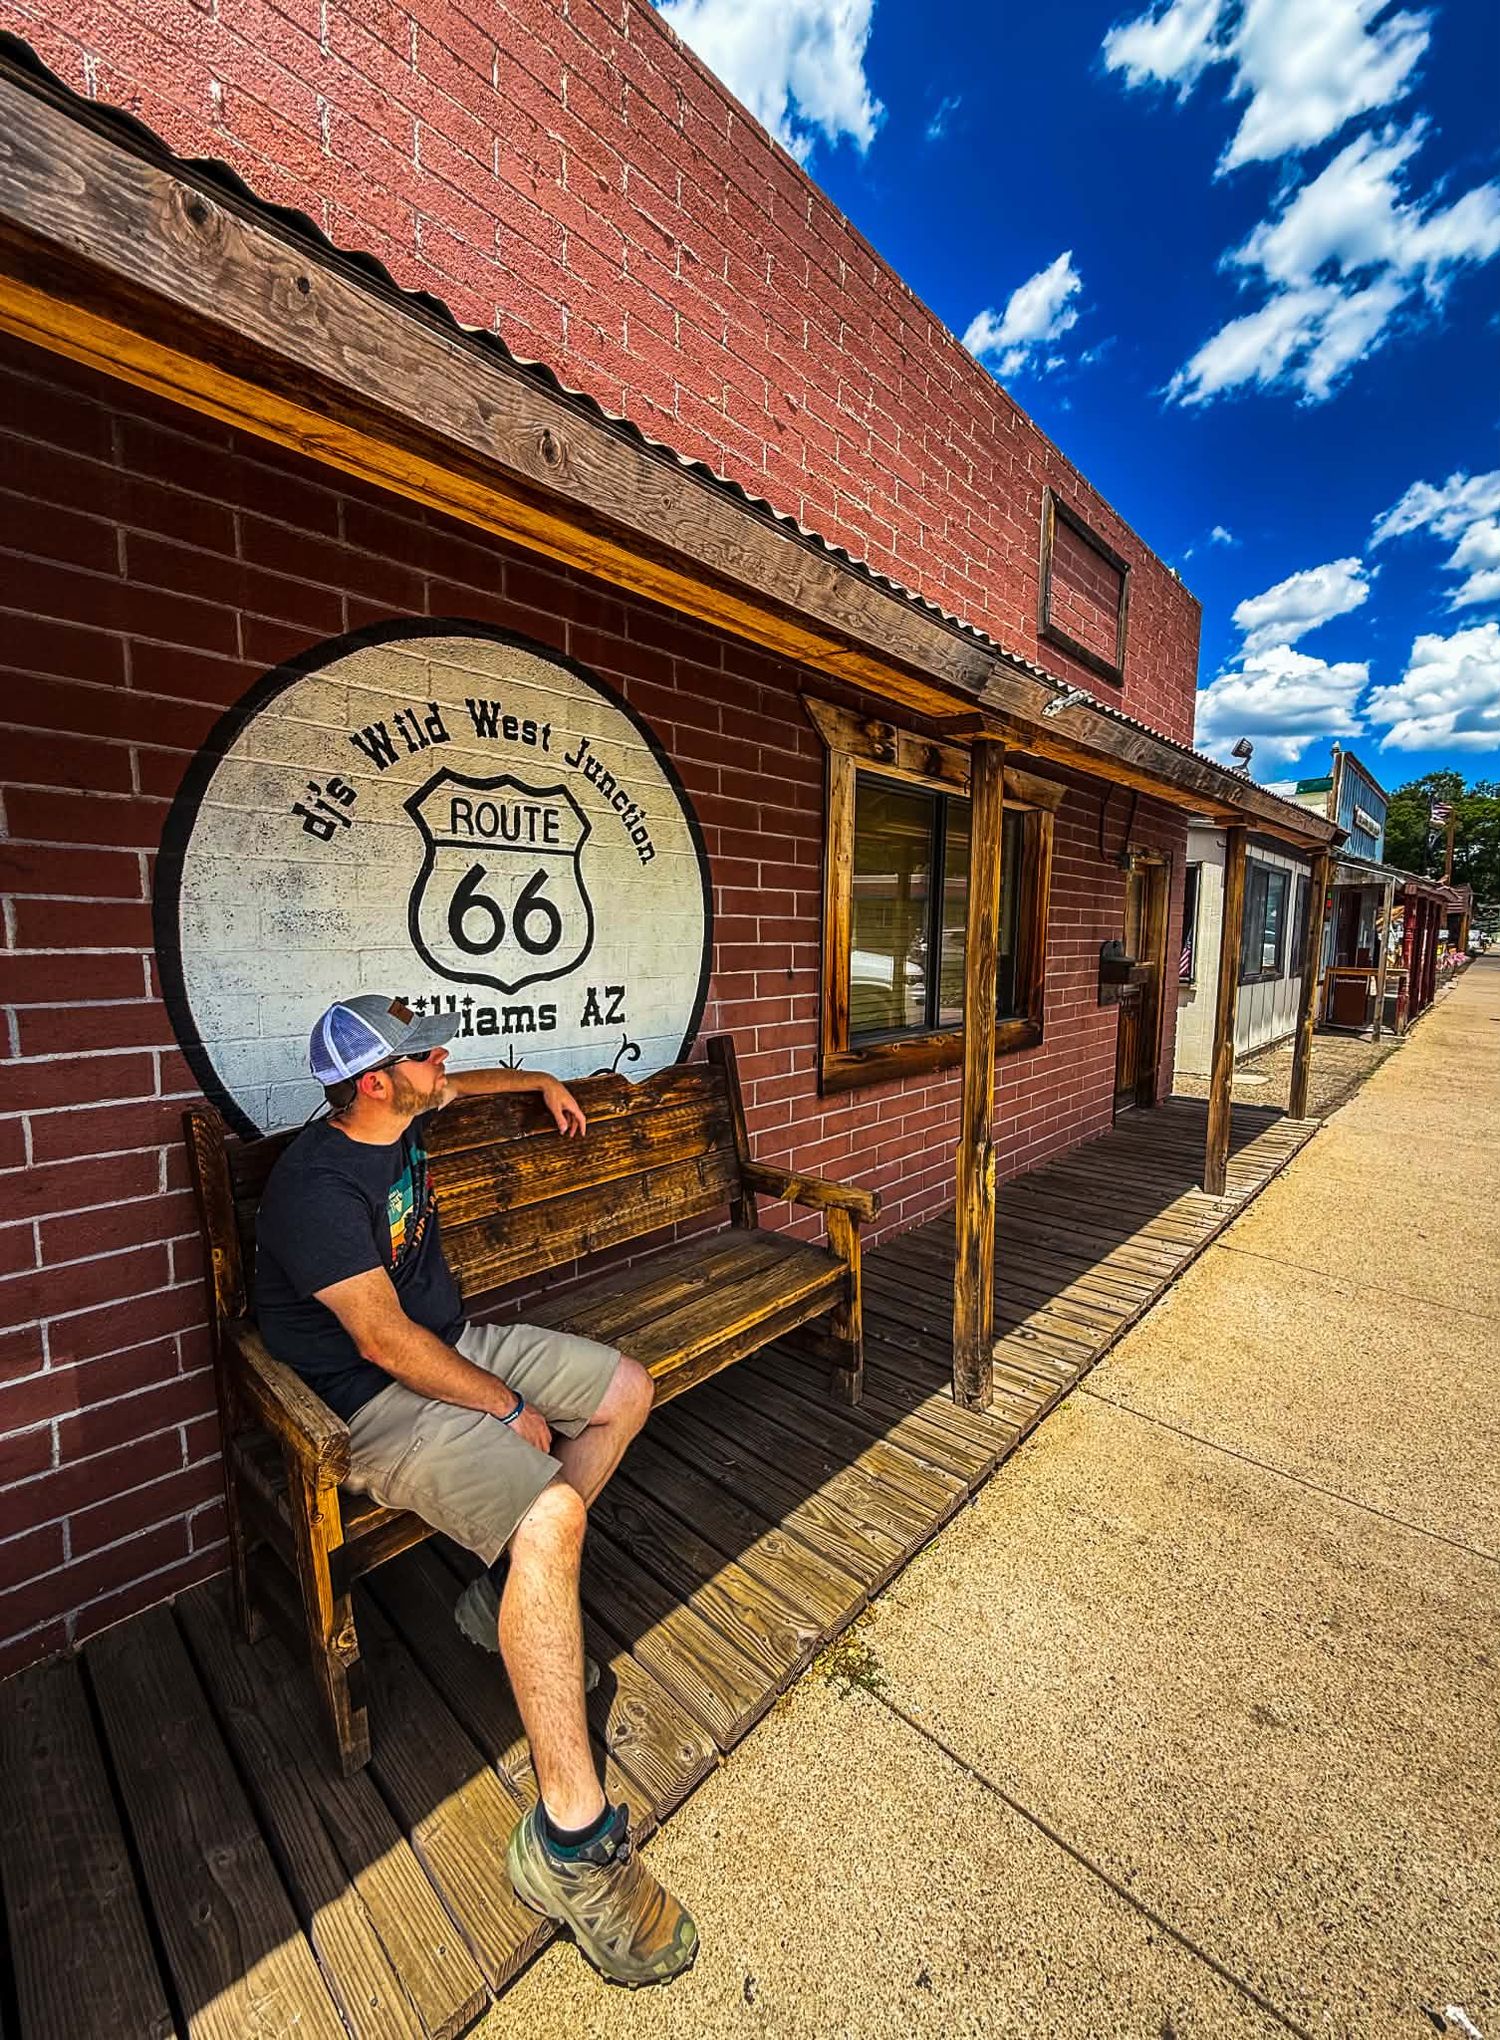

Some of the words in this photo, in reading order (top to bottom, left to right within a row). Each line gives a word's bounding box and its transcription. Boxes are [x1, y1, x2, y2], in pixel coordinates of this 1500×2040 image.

[348, 701, 450, 772] Wild
[464, 698, 552, 752] West
[564, 737, 657, 866] Junction
[451, 798, 559, 844] ROUTE
[448, 863, 562, 956] 66
[580, 985, 626, 1028] AZ
